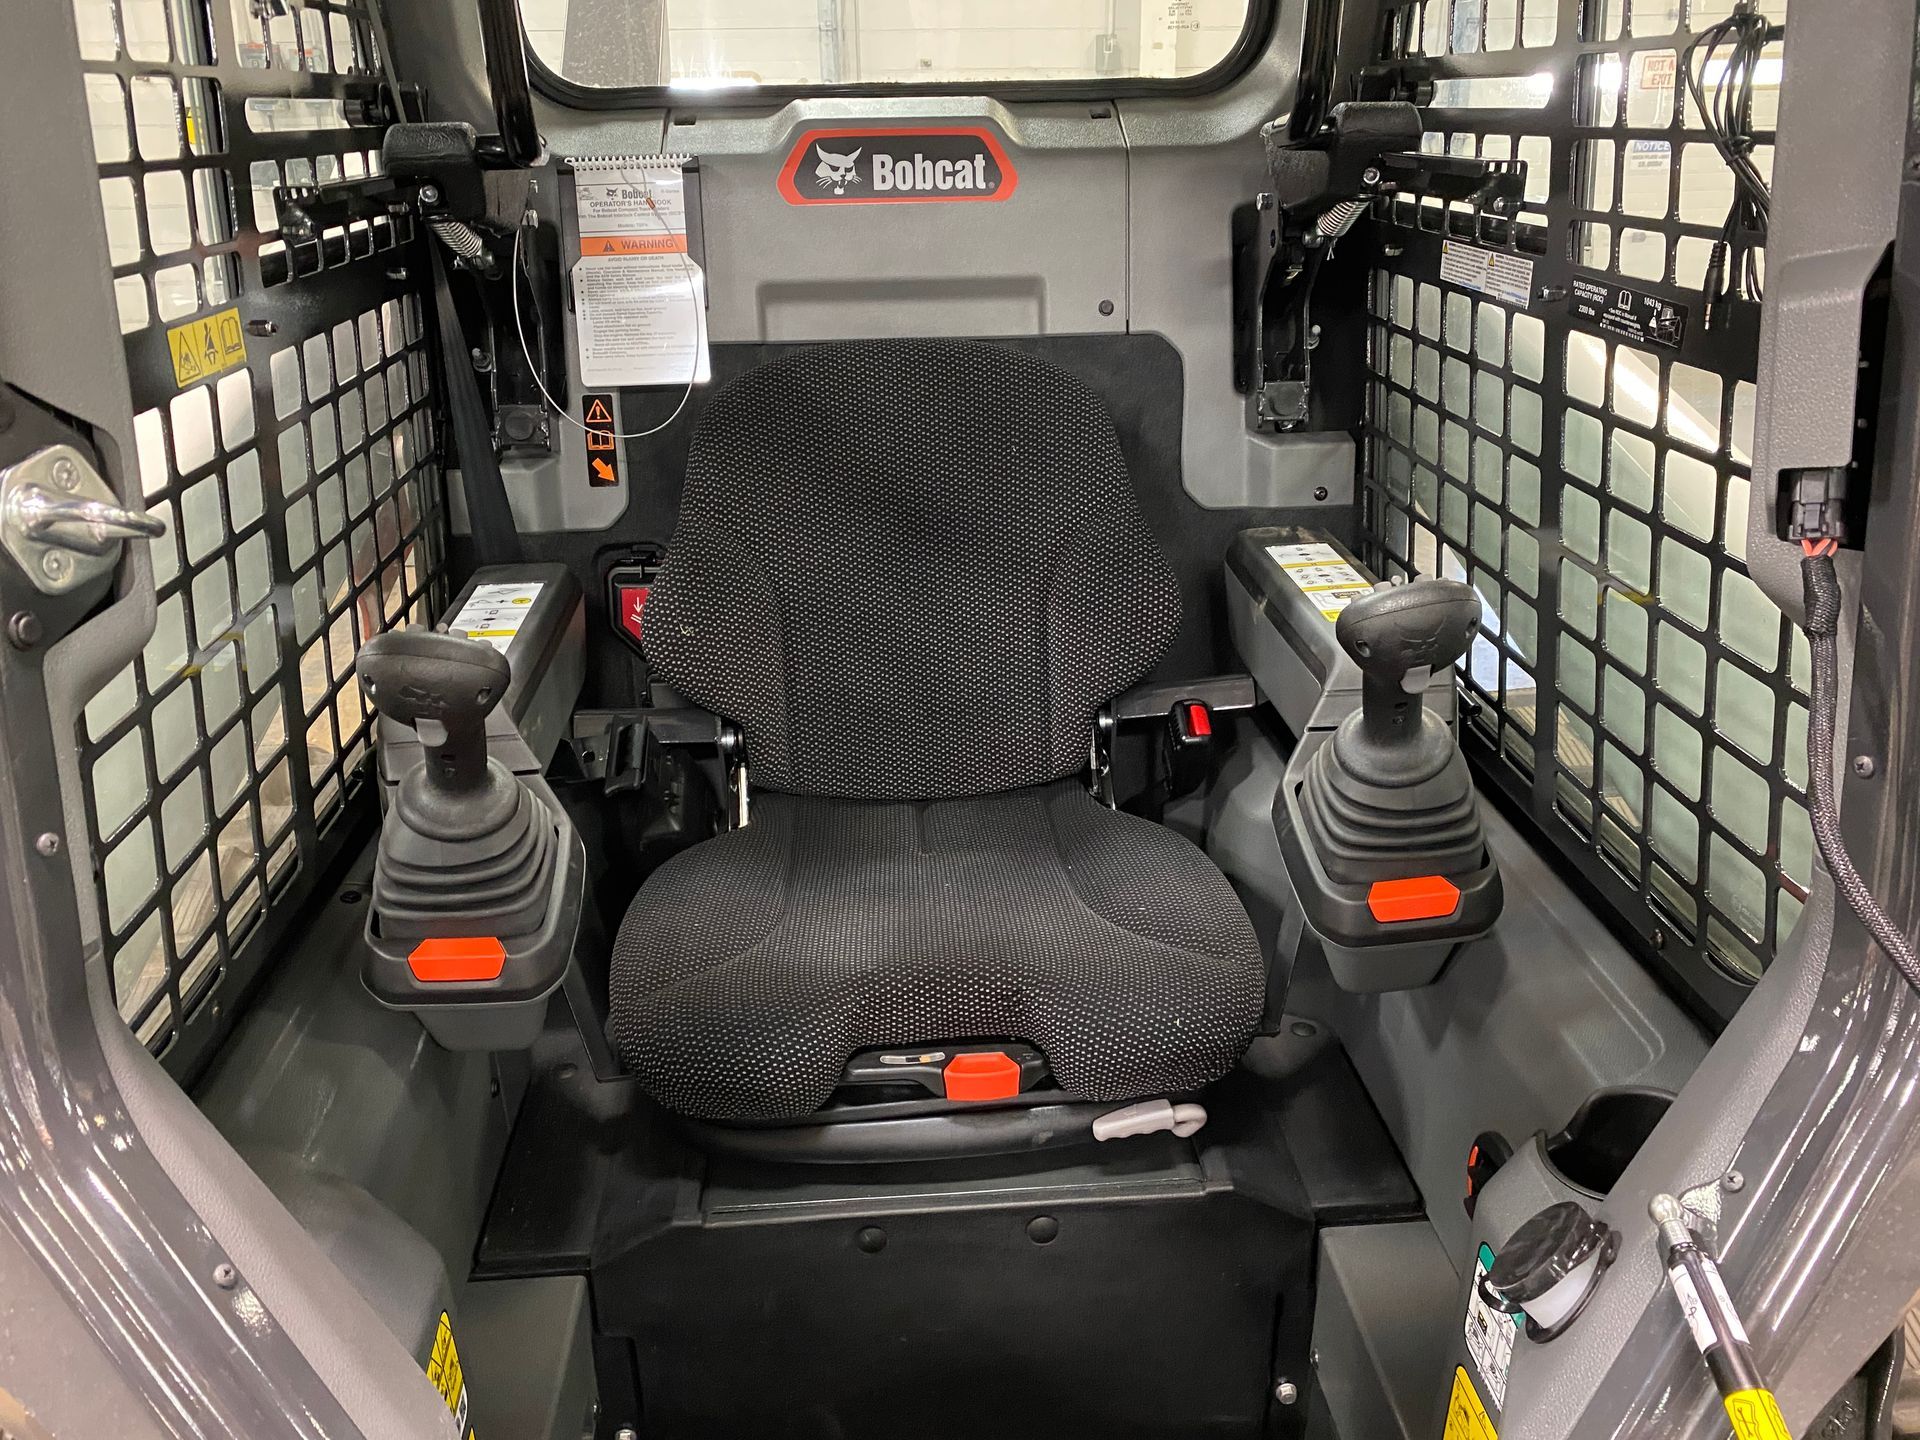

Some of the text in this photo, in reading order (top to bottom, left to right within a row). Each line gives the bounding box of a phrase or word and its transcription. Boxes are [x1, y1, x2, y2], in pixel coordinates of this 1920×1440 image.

[1648, 59, 1666, 71] NOT
[1652, 74, 1672, 85] EXIT
[1634, 142, 1670, 151] NOTICE
[872, 153, 986, 191] Bobcat
[590, 200, 632, 208] OPERATOR'S
[621, 239, 674, 250] WARNING
[1573, 280, 1608, 296] RATED OPERATING
[1574, 288, 1592, 299] CAPACITY
